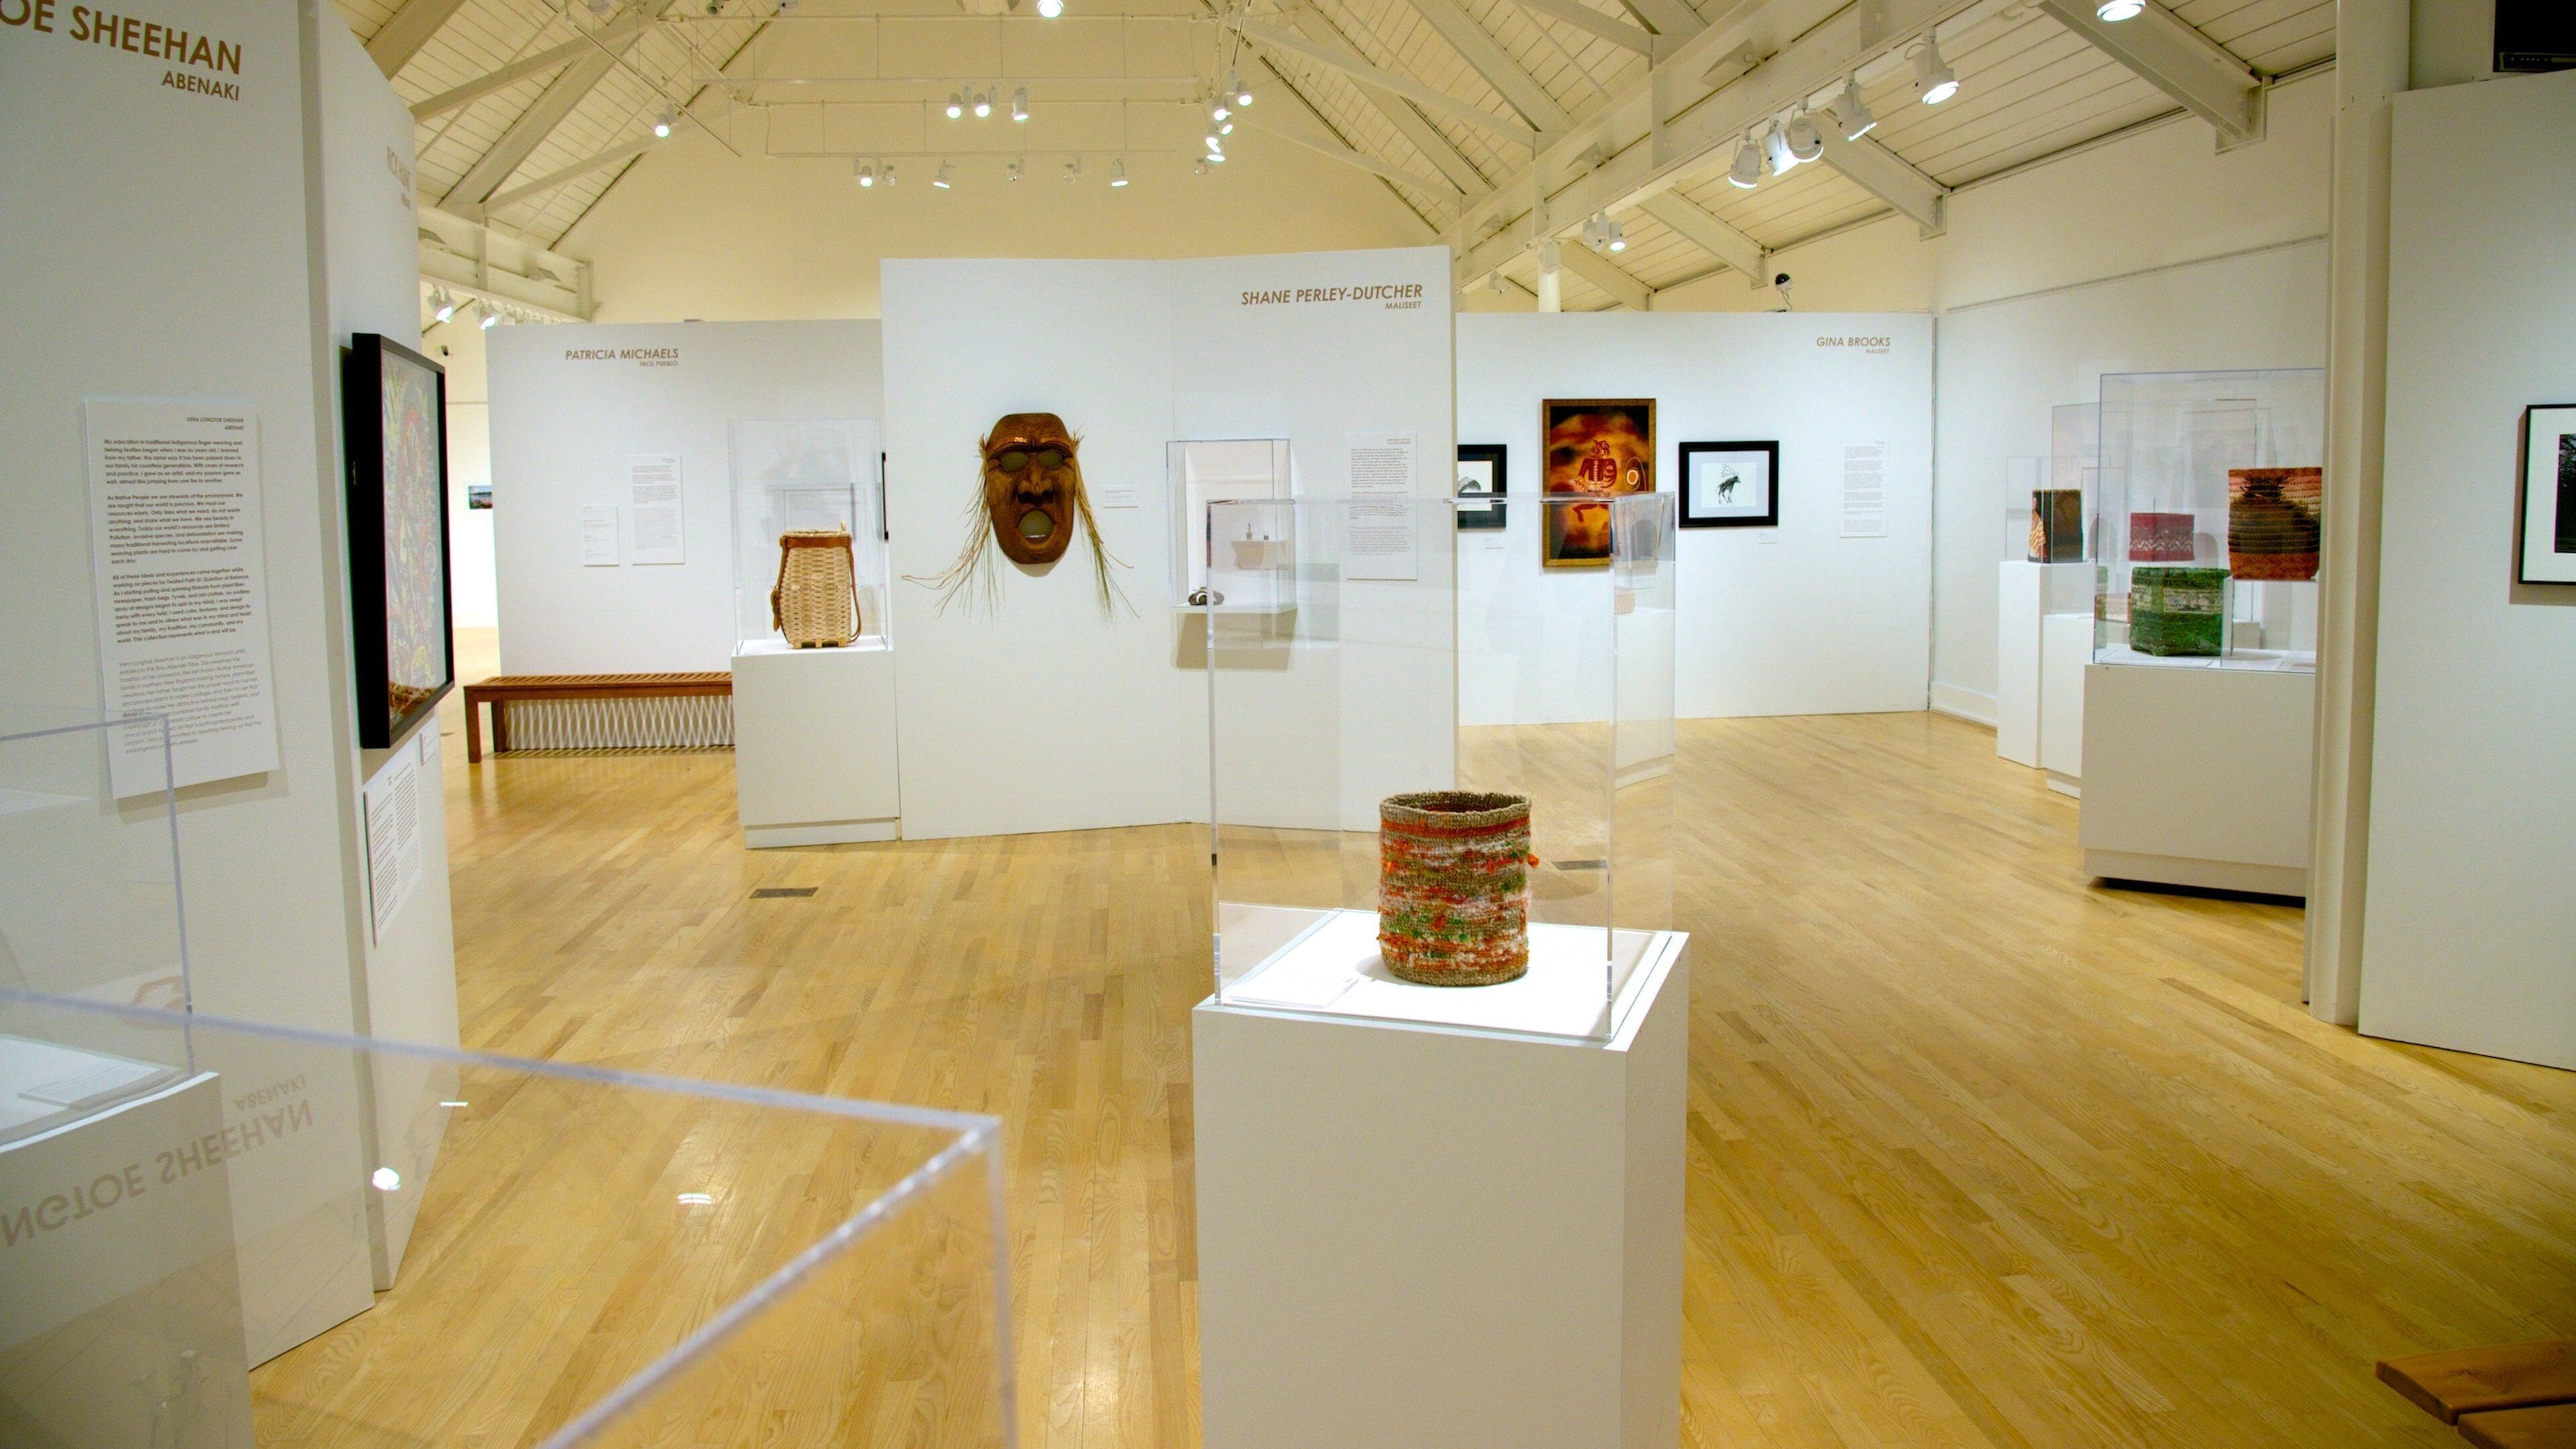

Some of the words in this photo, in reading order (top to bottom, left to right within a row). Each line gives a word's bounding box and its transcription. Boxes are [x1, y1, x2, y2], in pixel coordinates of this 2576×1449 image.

[69, 5, 241, 75] SHEEHAN
[162, 70, 239, 101] ABENAKI
[1241, 290, 1291, 305] SHANE
[1295, 284, 1423, 303] PERLEY-DUTCHER
[1385, 301, 1421, 310] MALISEET
[1817, 336, 1844, 347] GINA
[1847, 336, 1891, 347] BROOKS
[566, 349, 616, 360] PATRICIA
[620, 348, 680, 360] MICHAELS
